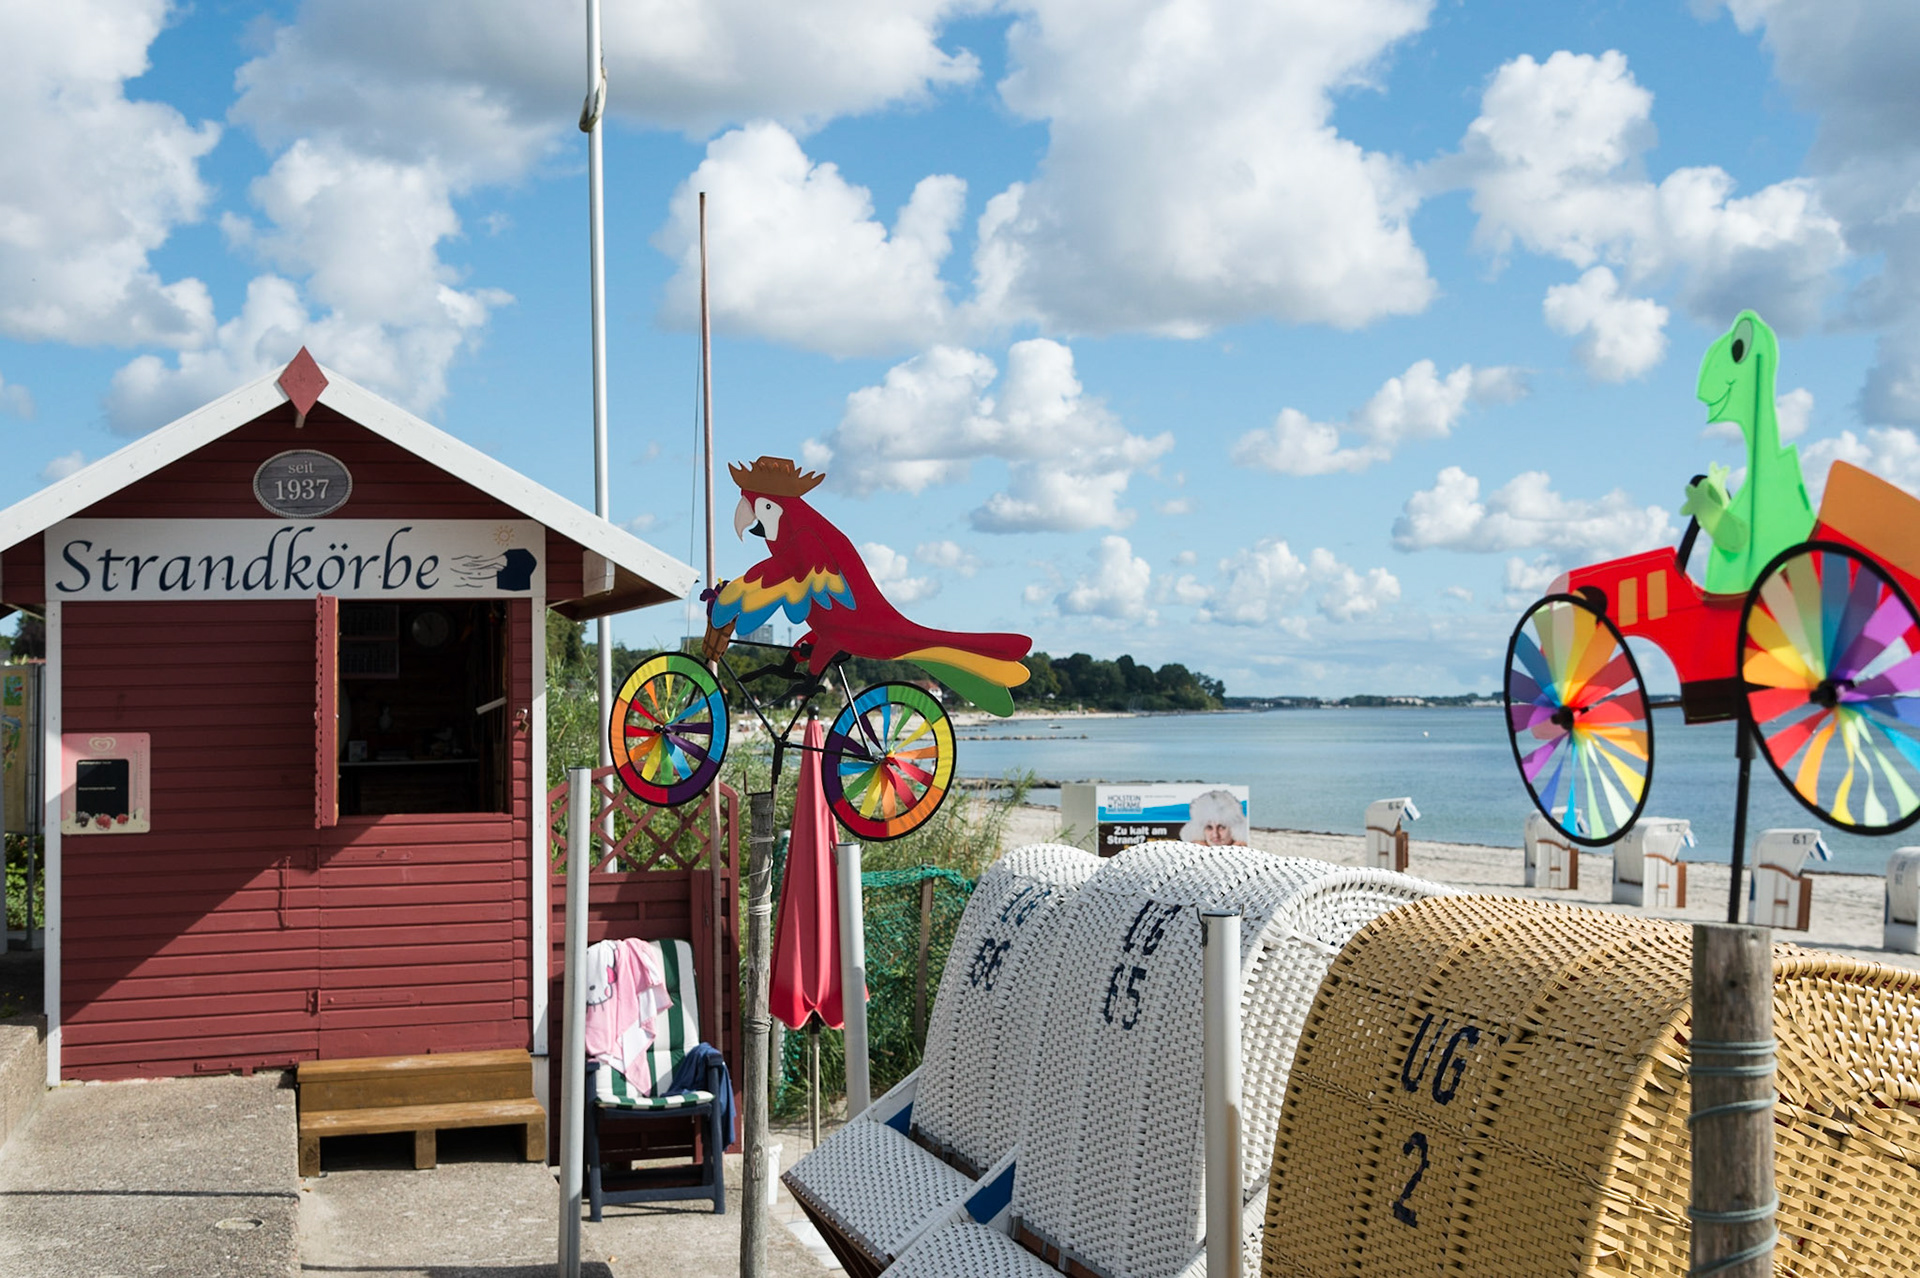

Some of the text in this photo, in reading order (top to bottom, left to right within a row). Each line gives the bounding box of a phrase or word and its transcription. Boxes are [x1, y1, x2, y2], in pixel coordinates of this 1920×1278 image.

[288, 461, 315, 474] seit
[275, 479, 330, 500] 1937
[55, 526, 440, 593] Strandkörbe
[1106, 835, 1145, 844] Strand?
[1114, 826, 1167, 835] Zu kalt am
[1792, 833, 1807, 845] 61
[1103, 963, 1142, 1030] 65
[1401, 1013, 1480, 1105] UG
[1393, 1131, 1429, 1227] 2
